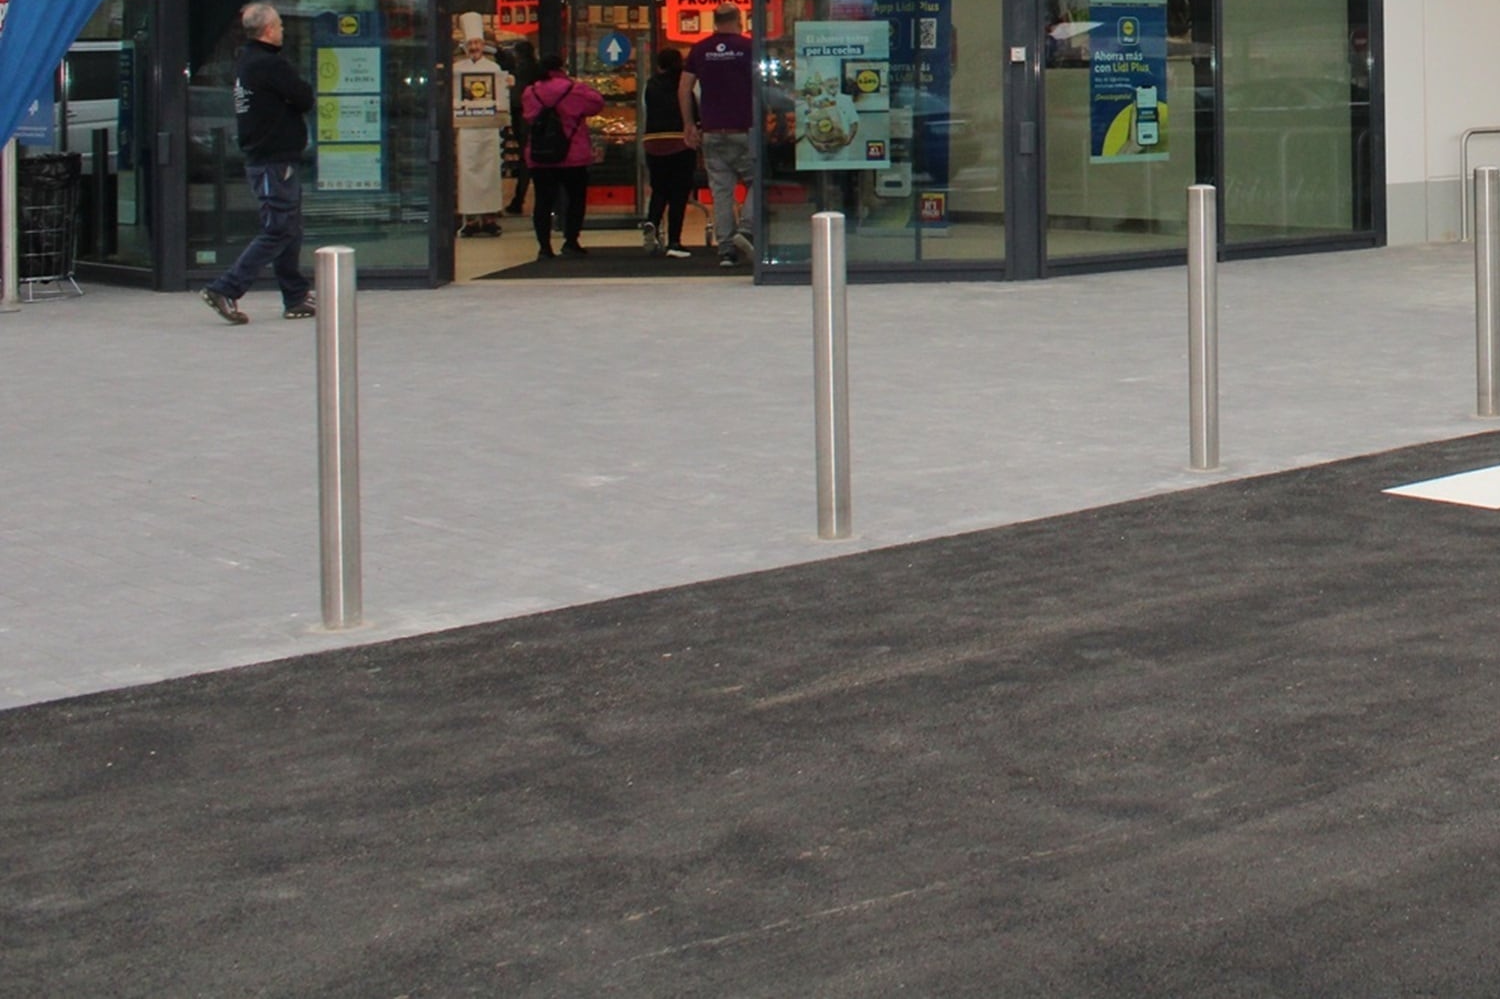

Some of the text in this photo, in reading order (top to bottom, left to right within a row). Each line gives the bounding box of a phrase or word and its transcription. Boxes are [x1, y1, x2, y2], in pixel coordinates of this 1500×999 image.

[806, 46, 862, 57] por la cocina
[1094, 50, 1143, 62] Ahorra más
[1094, 65, 1112, 73] con
[1130, 62, 1150, 73] Plus
